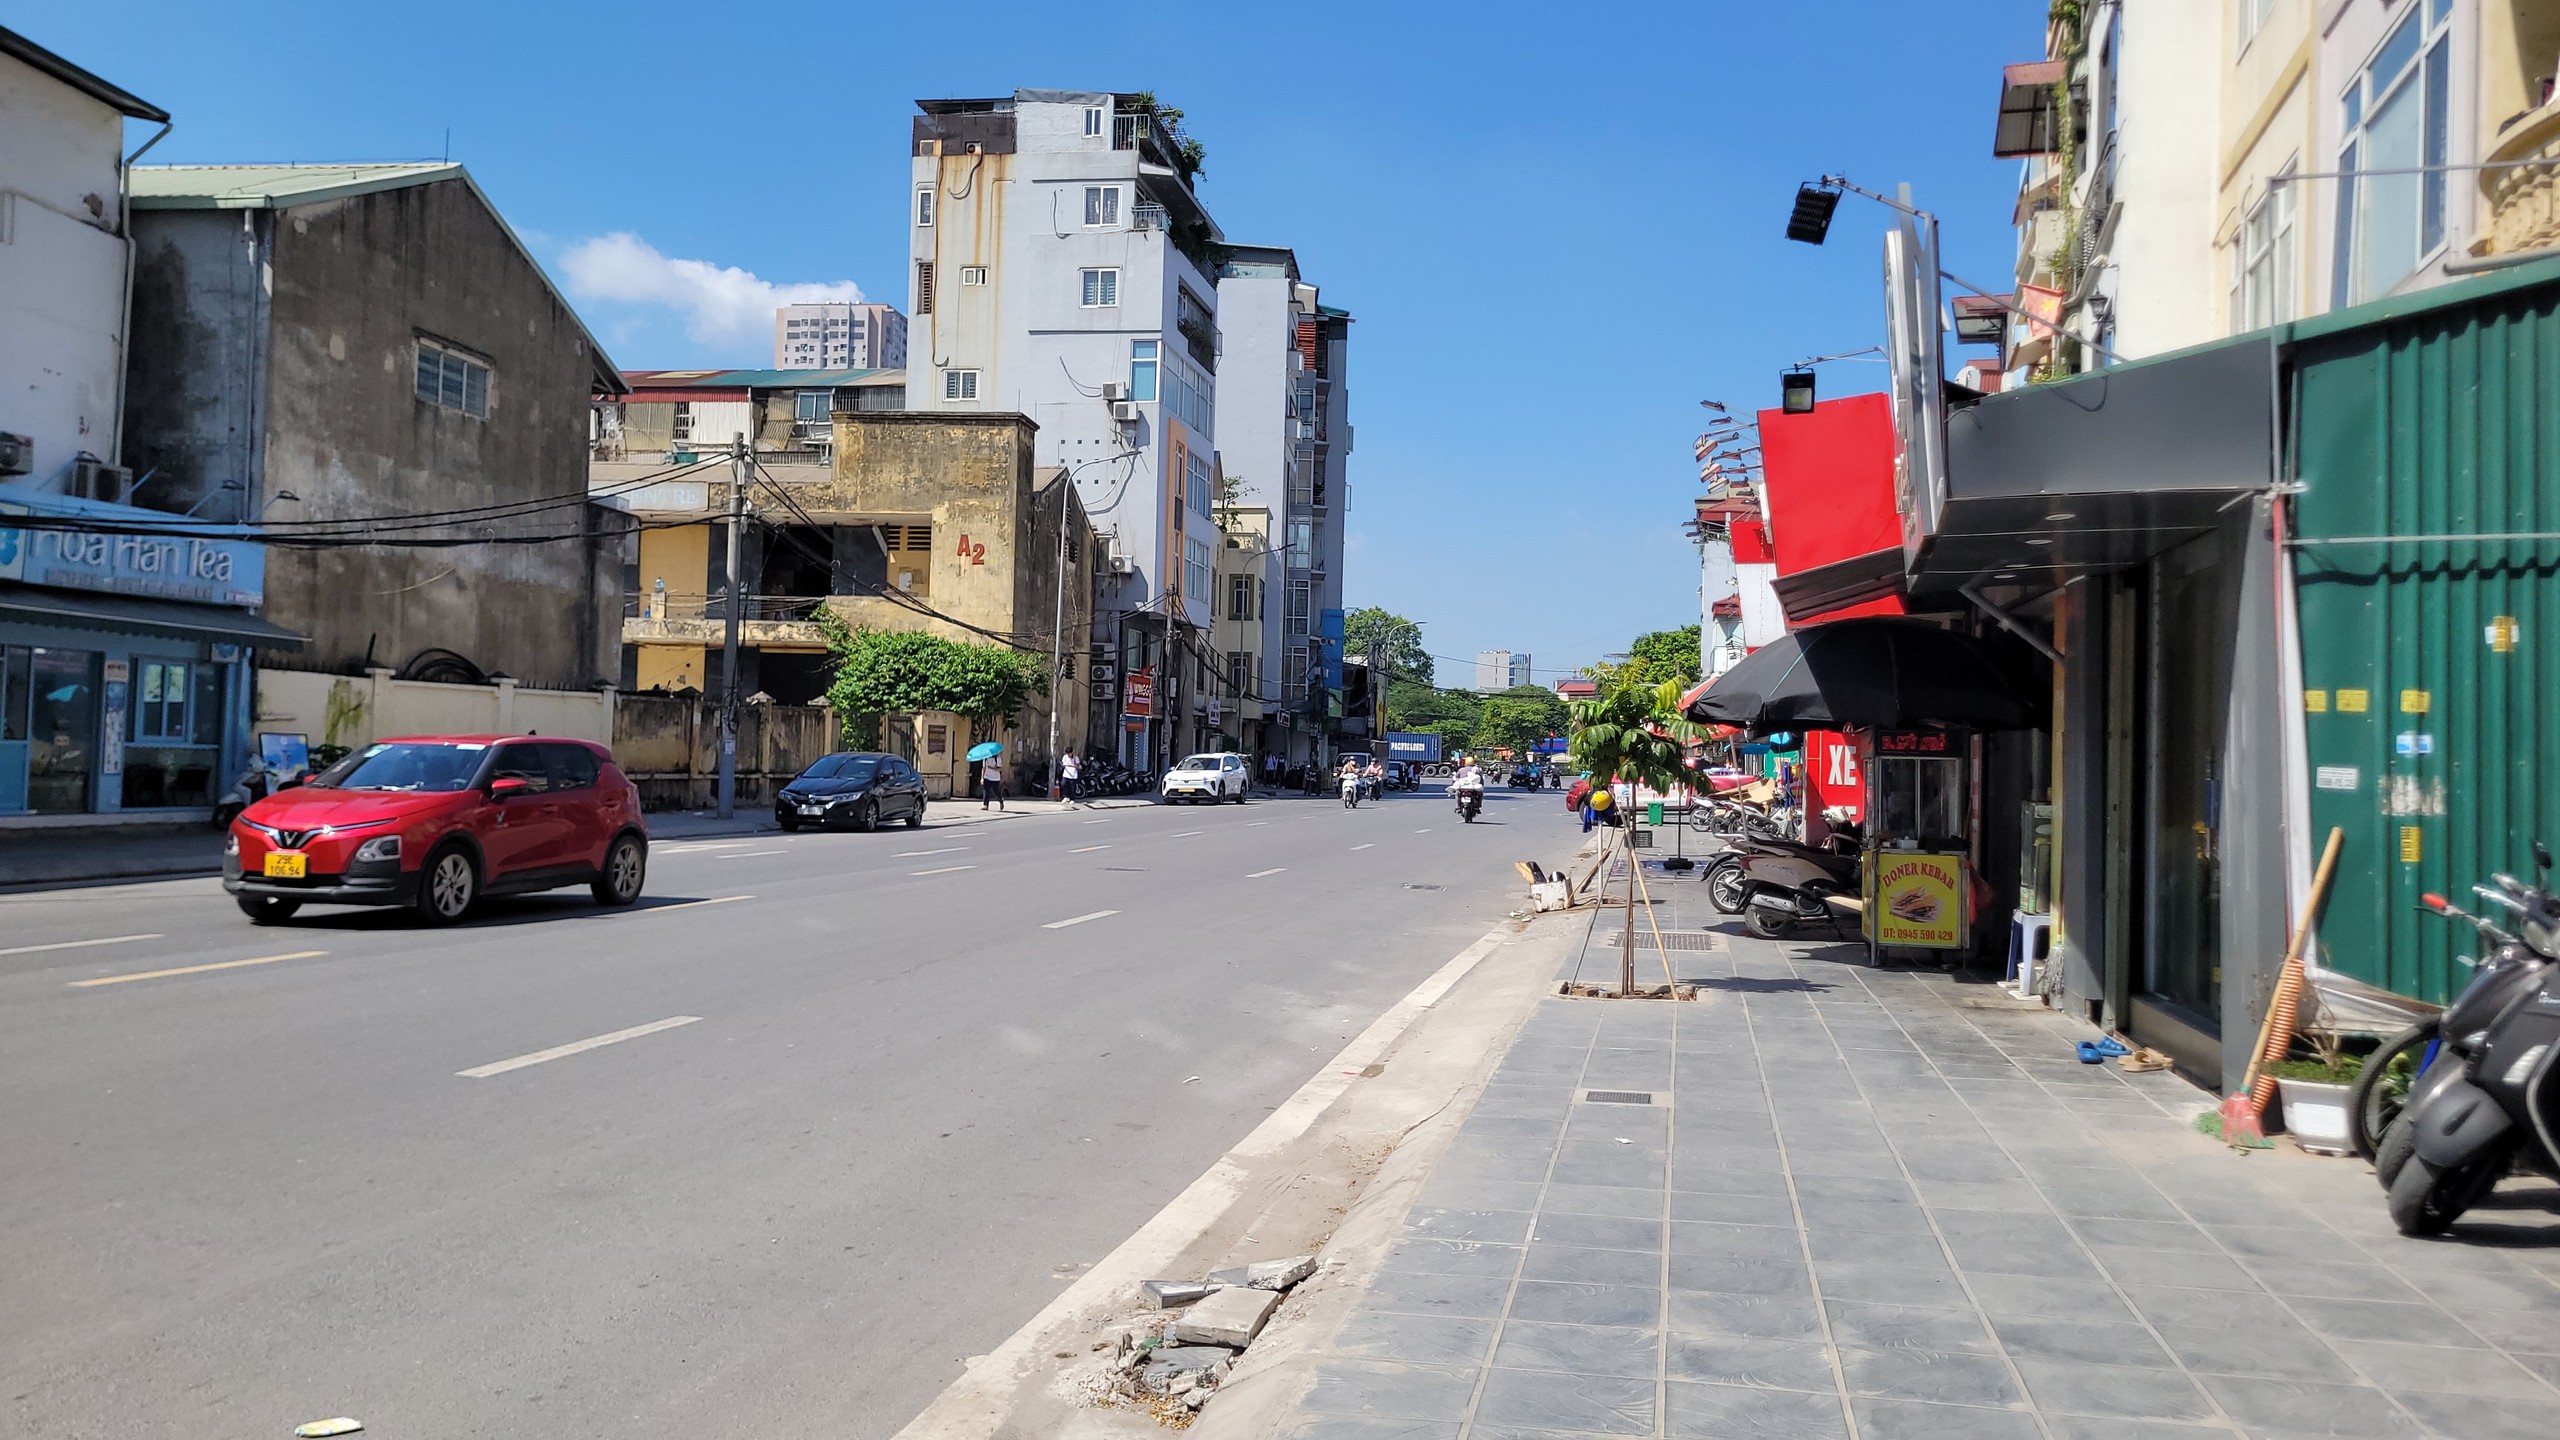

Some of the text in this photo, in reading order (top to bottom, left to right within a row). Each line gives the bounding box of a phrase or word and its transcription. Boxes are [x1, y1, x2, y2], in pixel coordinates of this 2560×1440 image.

[187, 538, 234, 582] Tea
[957, 534, 985, 565] A2
[1828, 745, 1857, 786] XE
[1882, 862, 1955, 891] DONER KEBAB
[1897, 928, 1918, 939] 0945
[1920, 929, 1936, 940] 590
[1938, 930, 1953, 941] 429
